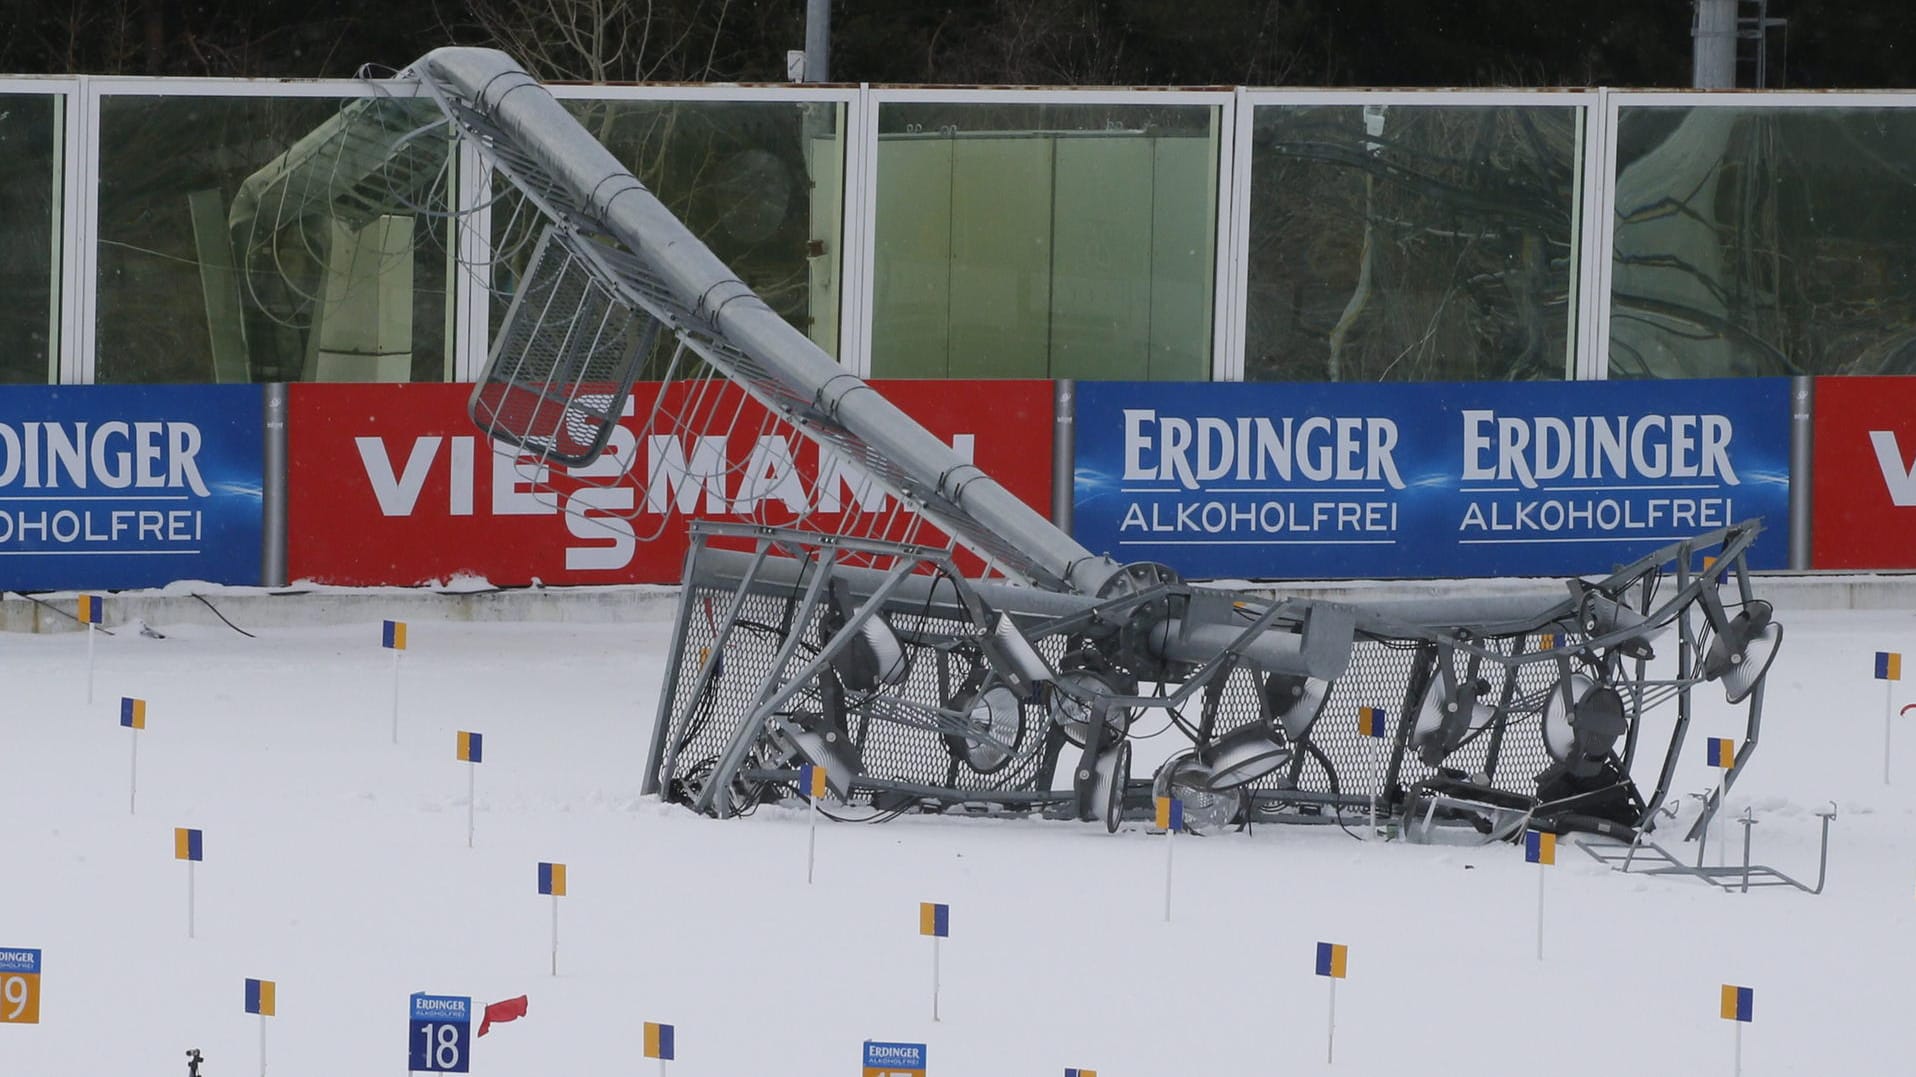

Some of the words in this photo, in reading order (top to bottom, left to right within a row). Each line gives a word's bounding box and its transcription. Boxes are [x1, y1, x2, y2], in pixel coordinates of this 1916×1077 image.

[1122, 408, 1407, 490] ERDINGER
[1461, 409, 1741, 489] ERDINGER
[1119, 501, 1398, 533] ALKOHOLFREI
[1459, 499, 1732, 531] ALKOHOLFREI
[0, 975, 28, 1019] 9
[416, 998, 466, 1011] ERDINGER
[421, 1023, 459, 1069] 18
[869, 1045, 920, 1059] ERDINGER
